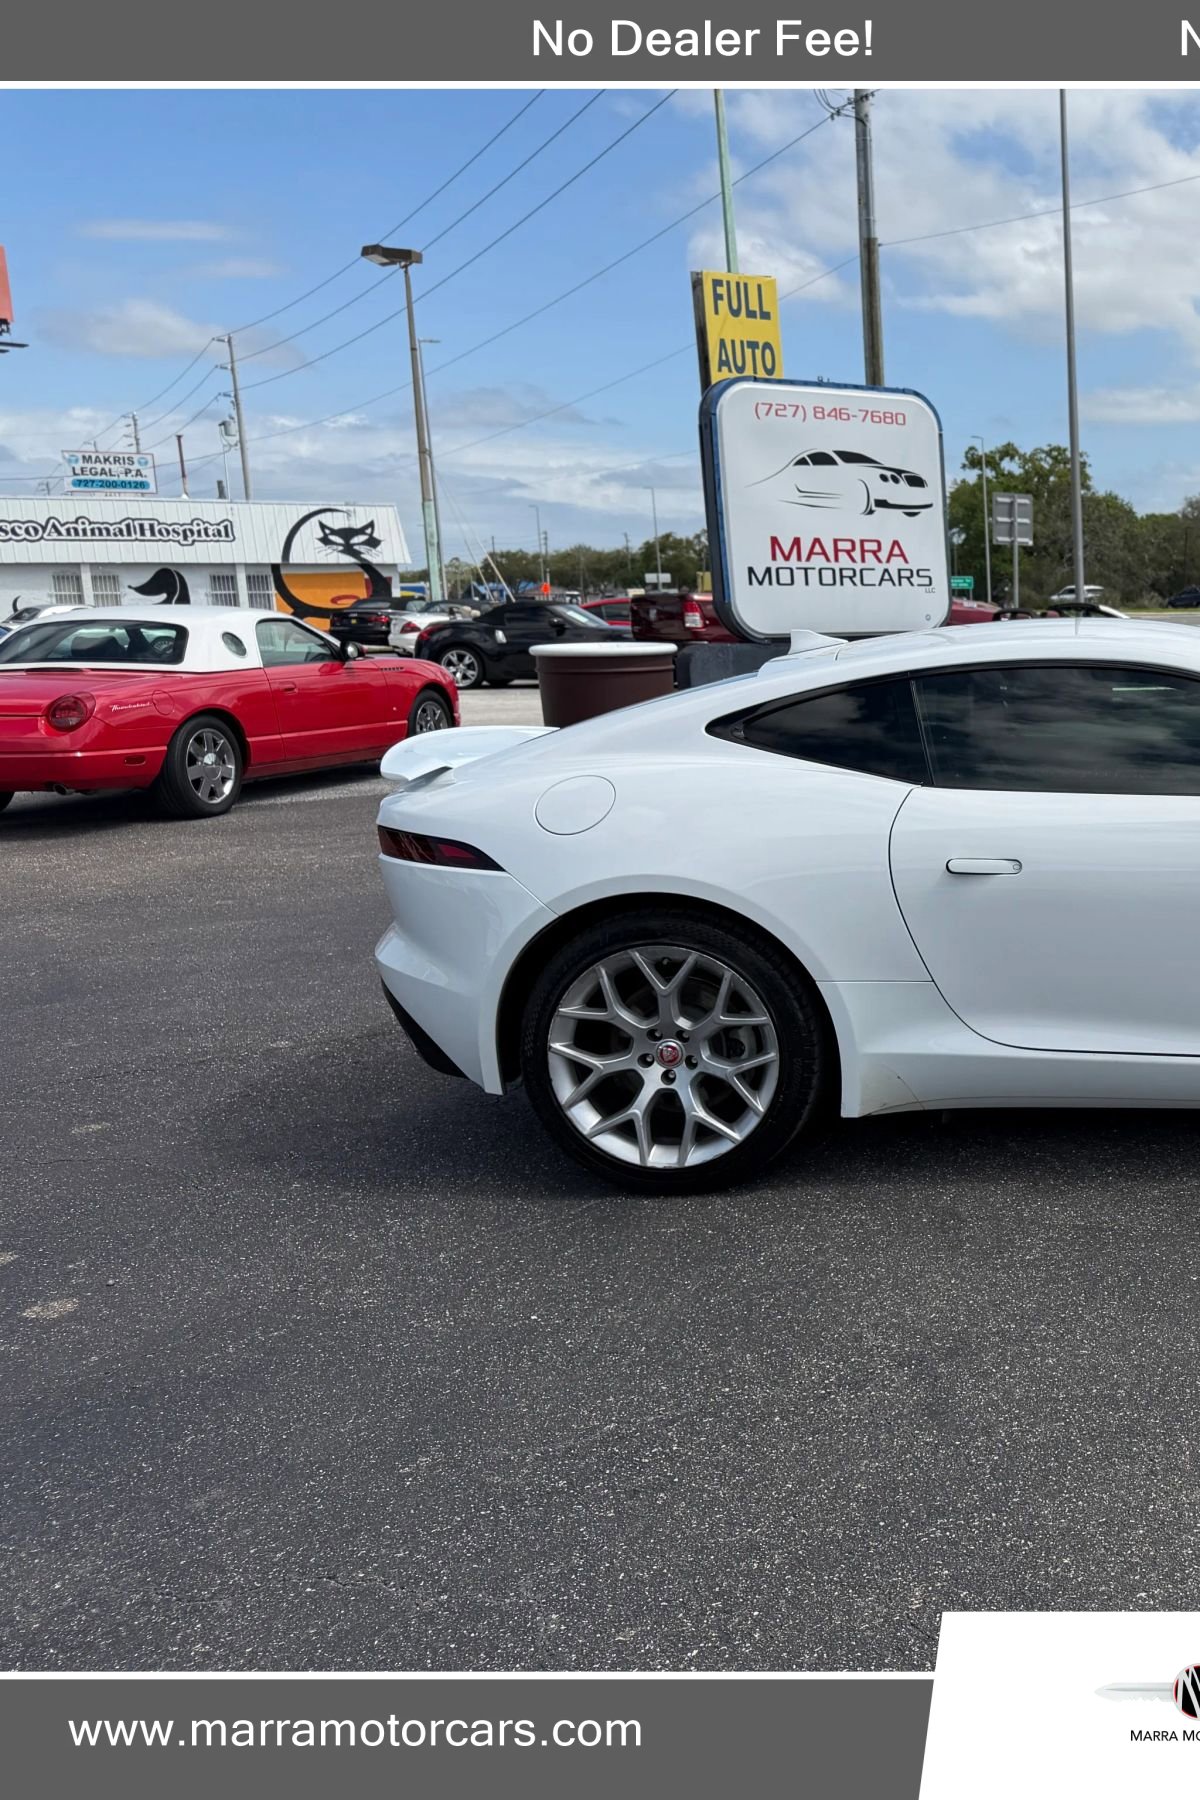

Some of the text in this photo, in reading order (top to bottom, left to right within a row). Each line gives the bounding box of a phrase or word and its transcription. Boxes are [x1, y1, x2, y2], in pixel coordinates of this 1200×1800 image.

[712, 278, 771, 320] FULL
[717, 338, 776, 376] AUTO
[754, 402, 906, 426] (727) 846-7680
[81, 454, 135, 465] MAKRIS
[124, 467, 148, 478] P.A.
[46, 520, 134, 538] Animal
[141, 520, 231, 541] Hospital
[770, 535, 909, 564] MARRA
[747, 566, 933, 587] MOTORCARS
